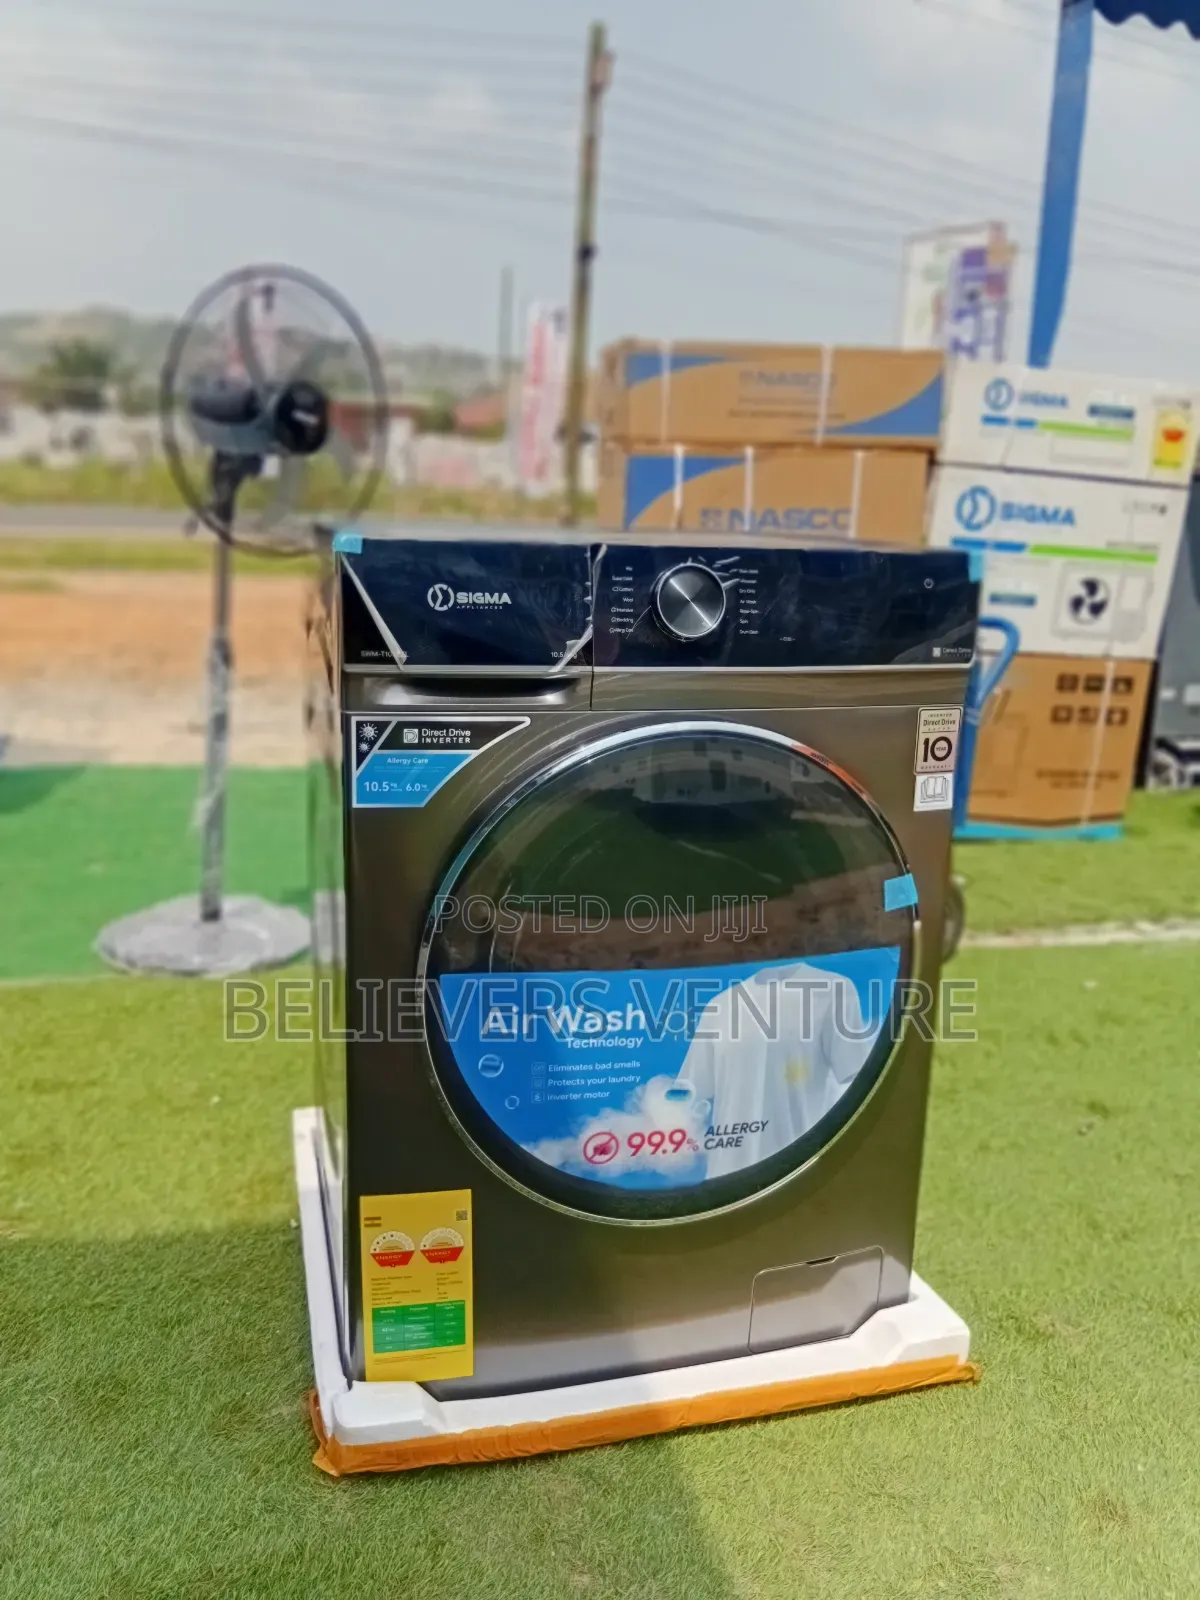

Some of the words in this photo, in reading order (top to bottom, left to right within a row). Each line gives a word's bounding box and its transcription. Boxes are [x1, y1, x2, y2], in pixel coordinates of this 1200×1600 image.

[1000, 500, 1076, 527] SIGMA
[456, 591, 513, 605] SIGMA
[923, 719, 940, 727] Direct
[941, 718, 956, 726] Drive
[421, 728, 447, 737] Direct
[448, 728, 471, 737] Drive
[922, 736, 953, 763] 10
[386, 756, 411, 766] Allergy
[412, 756, 429, 764] Care
[363, 781, 390, 792] 10.5
[405, 783, 421, 792] 6.0
[480, 1005, 537, 1035] Air
[547, 1003, 647, 1034] Wash
[566, 1034, 645, 1051] Technology
[548, 1063, 593, 1072] Eliminates
[594, 1061, 612, 1070] bad
[613, 1060, 641, 1069] smells
[547, 1078, 585, 1087] Protects
[586, 1077, 607, 1087] your
[608, 1075, 641, 1084] laundry
[583, 1090, 611, 1099] motor
[704, 1120, 769, 1138] ALLERGY
[704, 1136, 744, 1150] CARE
